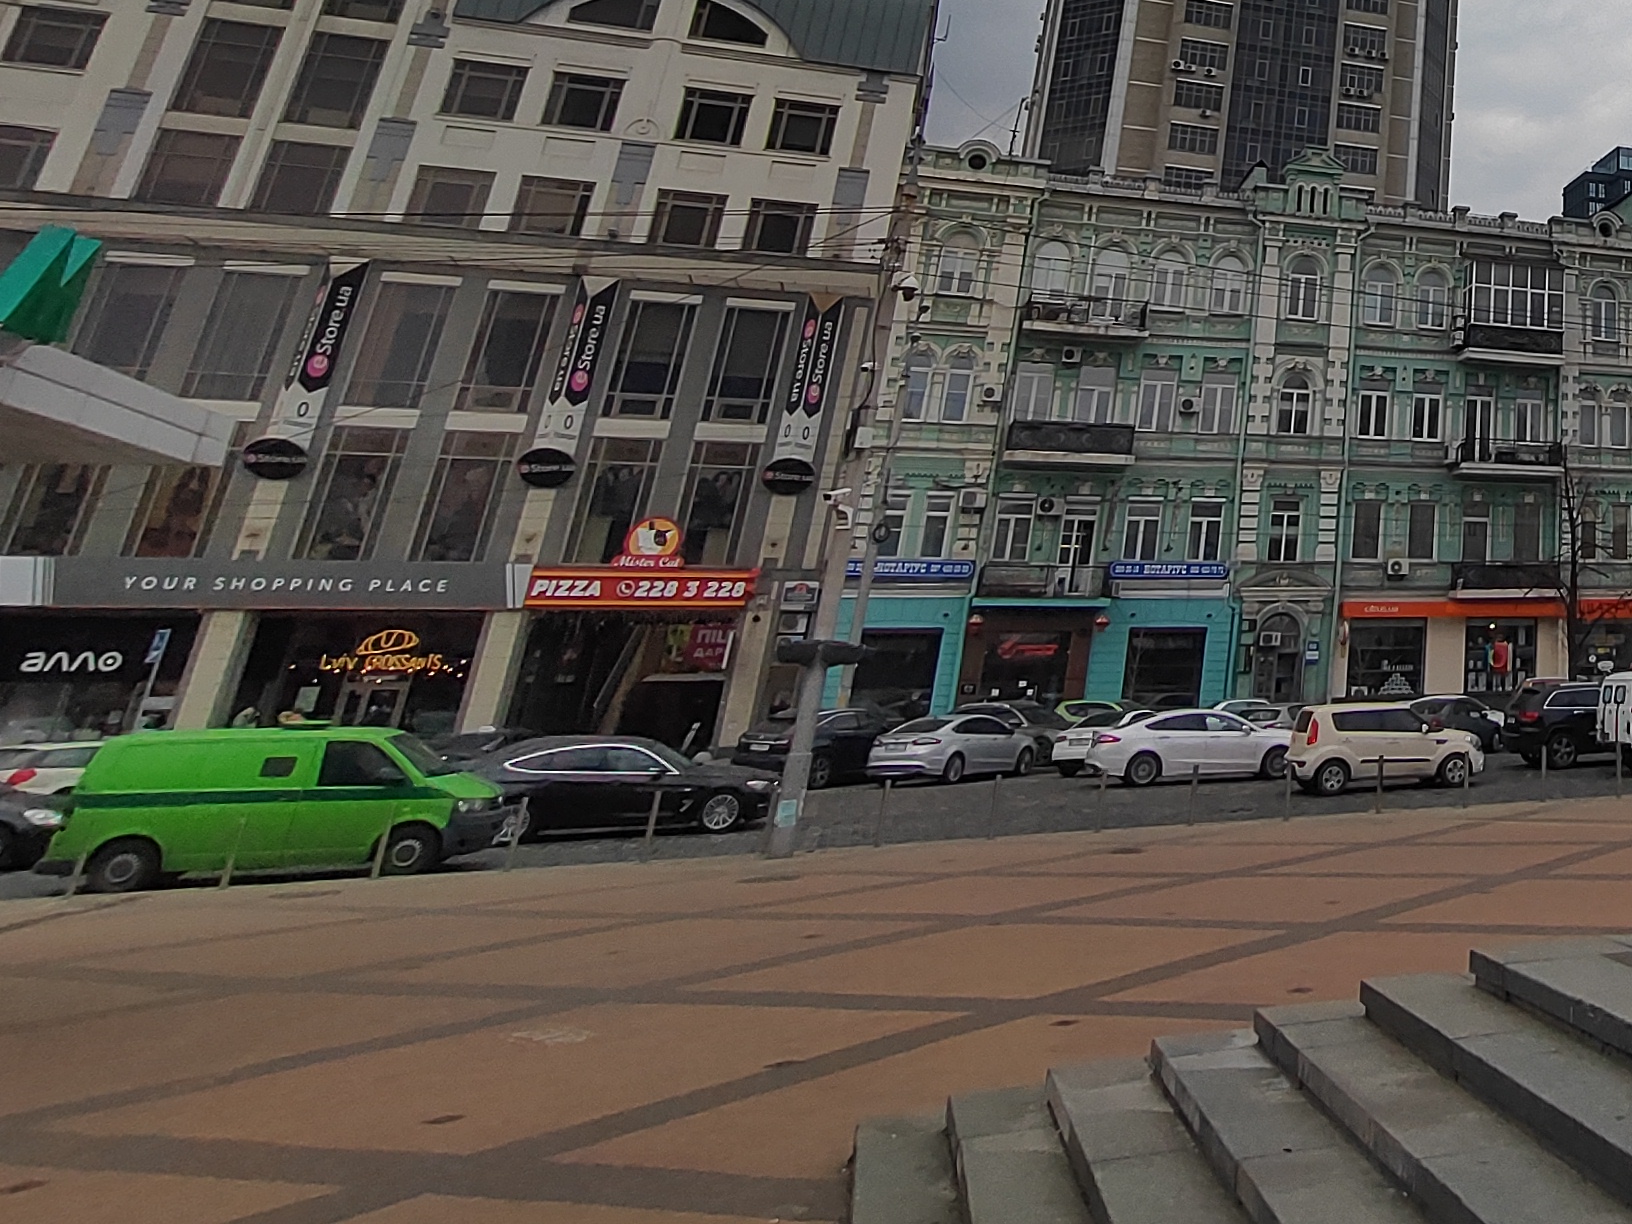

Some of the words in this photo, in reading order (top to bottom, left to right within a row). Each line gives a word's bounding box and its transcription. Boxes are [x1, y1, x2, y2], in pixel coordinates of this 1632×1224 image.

[123, 576, 197, 591] YOUR
[212, 577, 353, 592] SHOPPING
[367, 579, 449, 593] PLACE
[530, 579, 601, 597] PIZZA
[633, 580, 679, 597] 228
[683, 581, 699, 597] 3
[703, 581, 747, 598] 228
